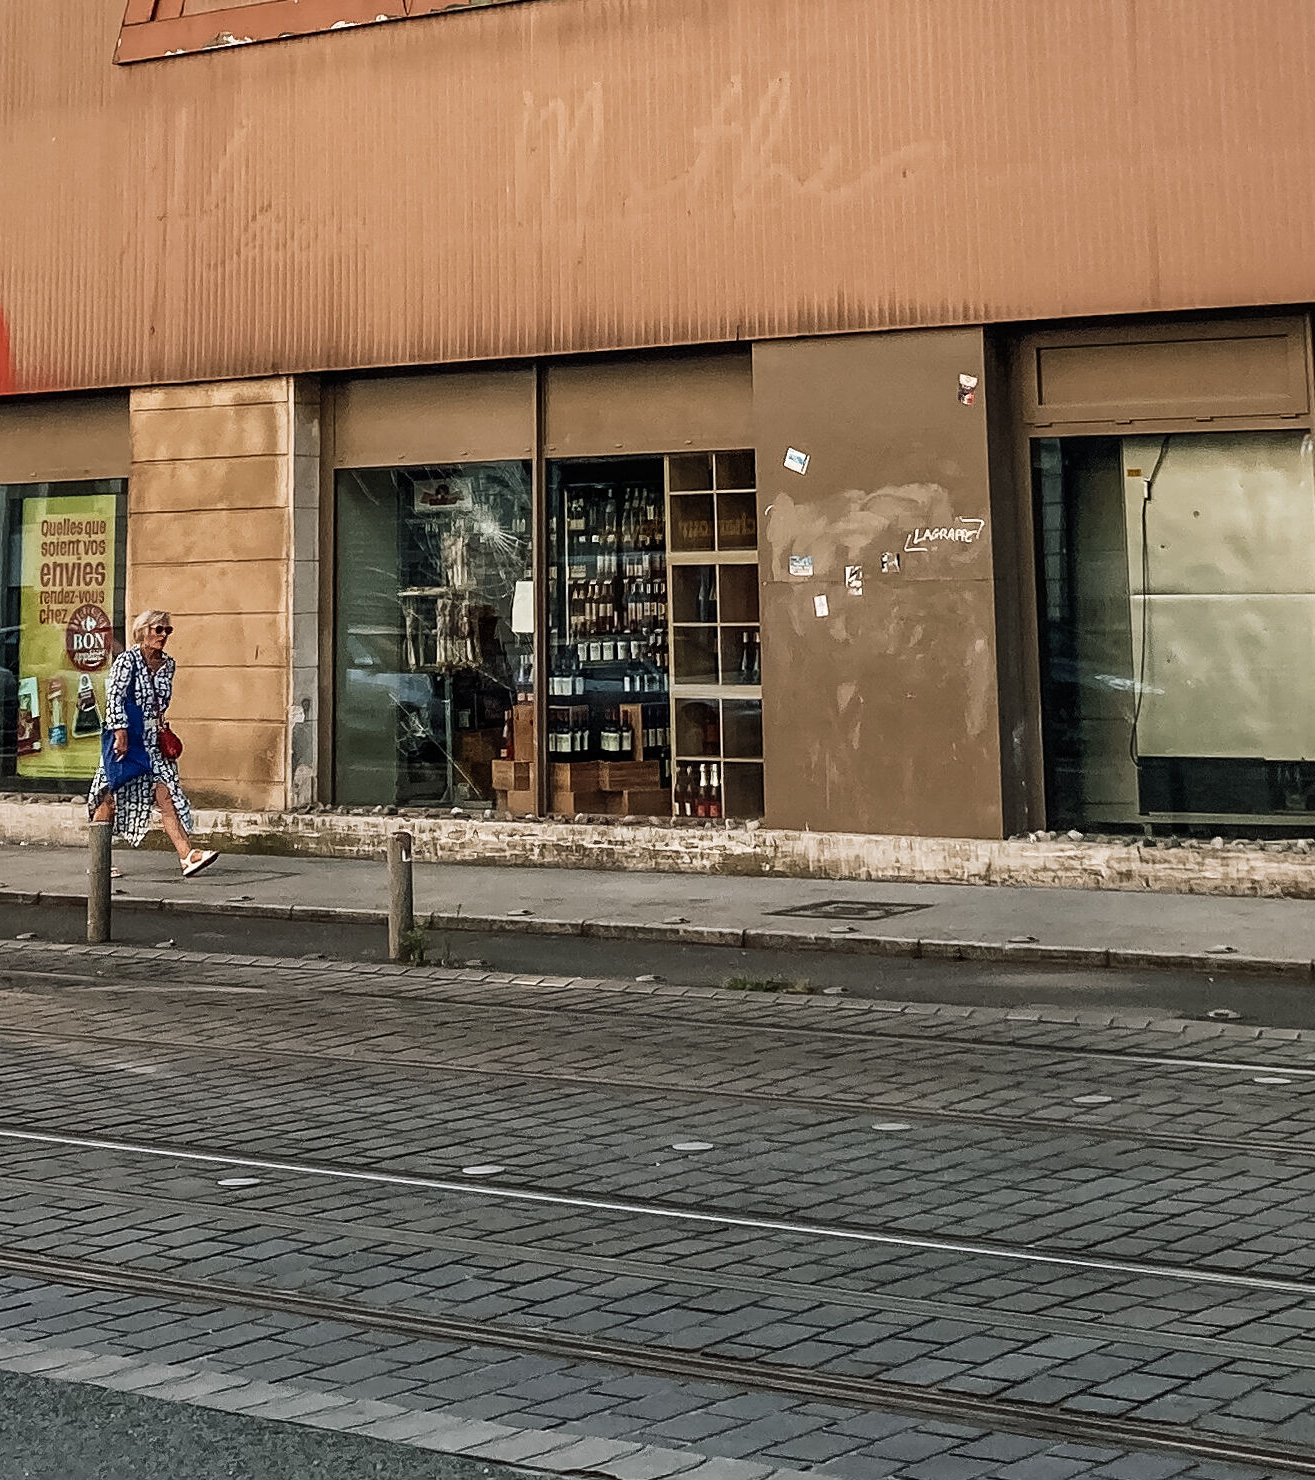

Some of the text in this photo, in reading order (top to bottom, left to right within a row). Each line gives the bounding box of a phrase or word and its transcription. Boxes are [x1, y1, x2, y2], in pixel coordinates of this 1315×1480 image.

[41, 518, 106, 539] Quelles que
[41, 539, 106, 557] soient vos
[40, 557, 106, 587] envies
[40, 588, 105, 605] rendez-vous
[39, 605, 68, 625] chez
[73, 631, 105, 650] BON
